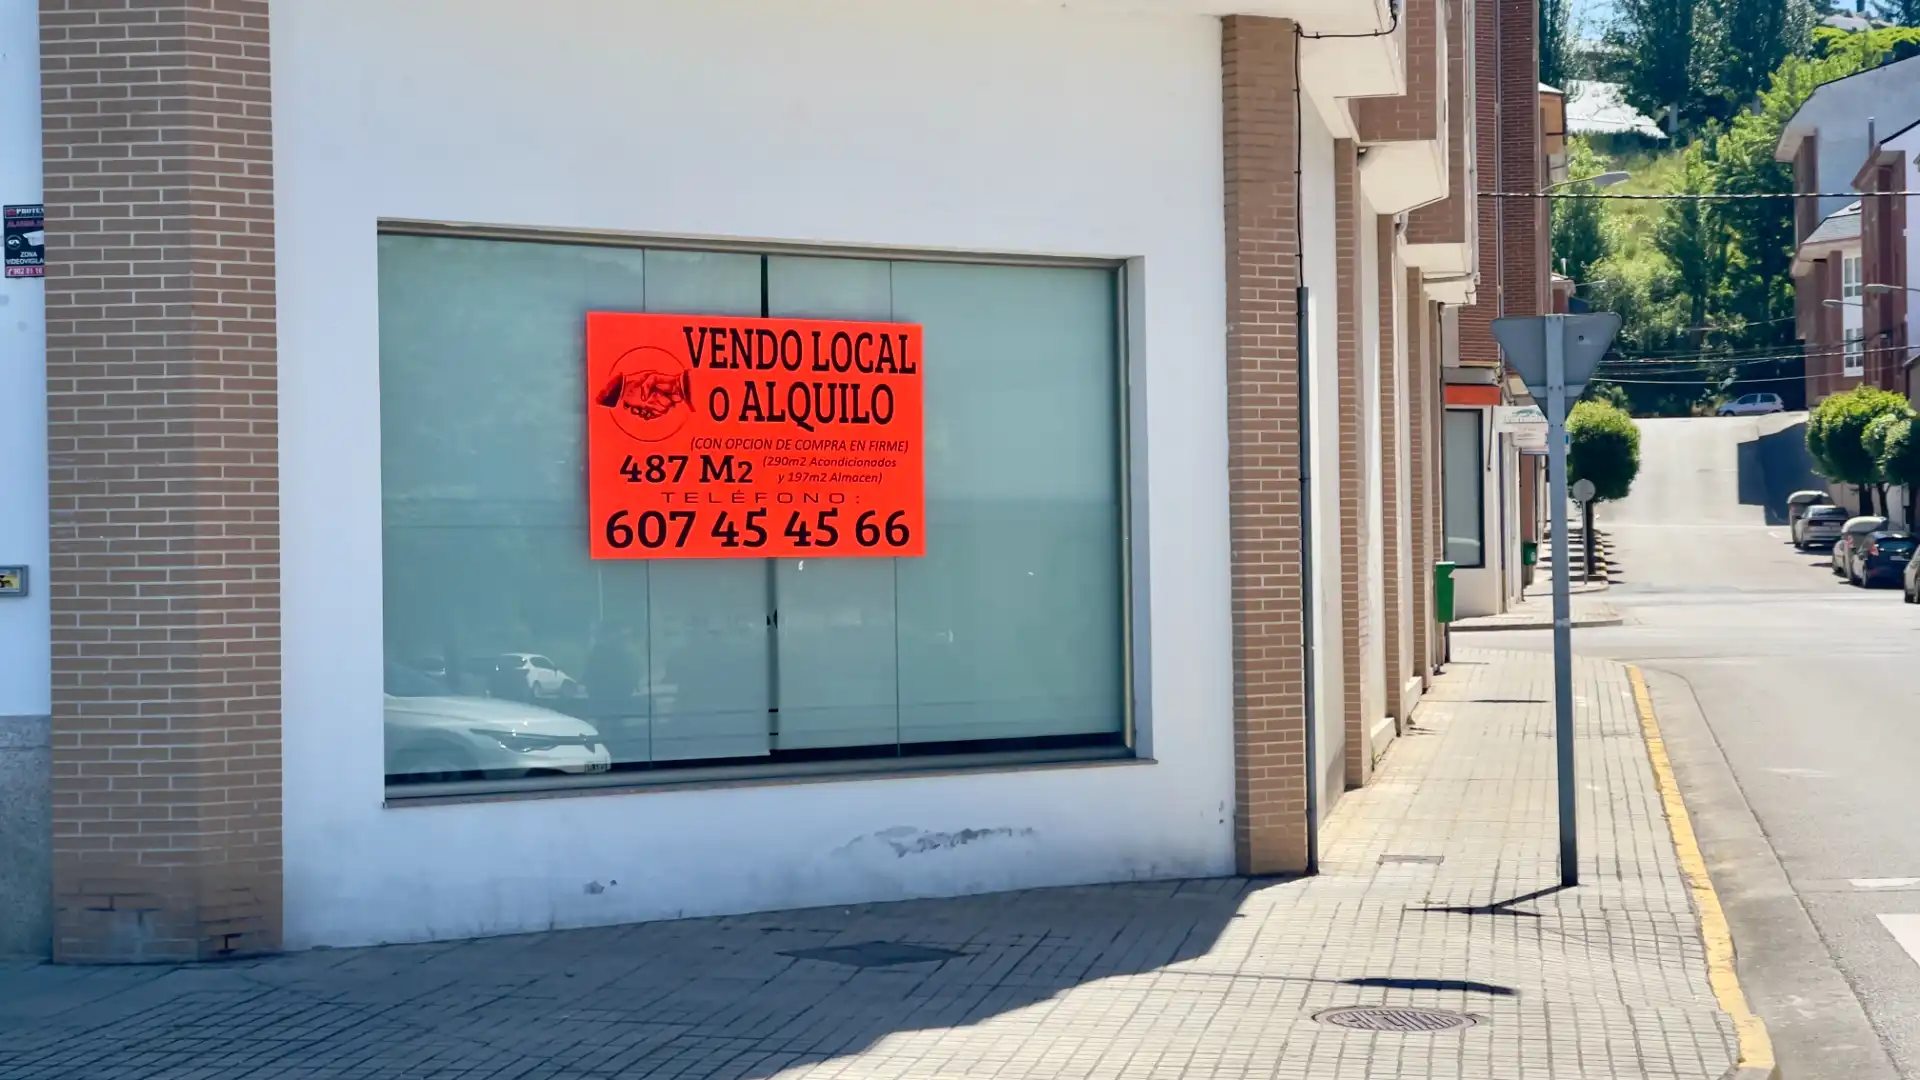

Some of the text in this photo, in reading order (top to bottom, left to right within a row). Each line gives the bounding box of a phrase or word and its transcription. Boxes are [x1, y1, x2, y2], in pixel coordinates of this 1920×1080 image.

[683, 326, 917, 375] VENDO LOCAL
[738, 380, 895, 433] ALQUILO
[690, 437, 909, 453] (CON OPCION DE COMPRA EN FIRME)
[619, 454, 753, 484] 487 M2
[762, 456, 897, 468] (290m2 Acondicionados
[777, 472, 883, 484] y 197m2 Almacen)
[661, 489, 861, 504] TELÉFONO:
[606, 507, 910, 549] 607 45 45 66
